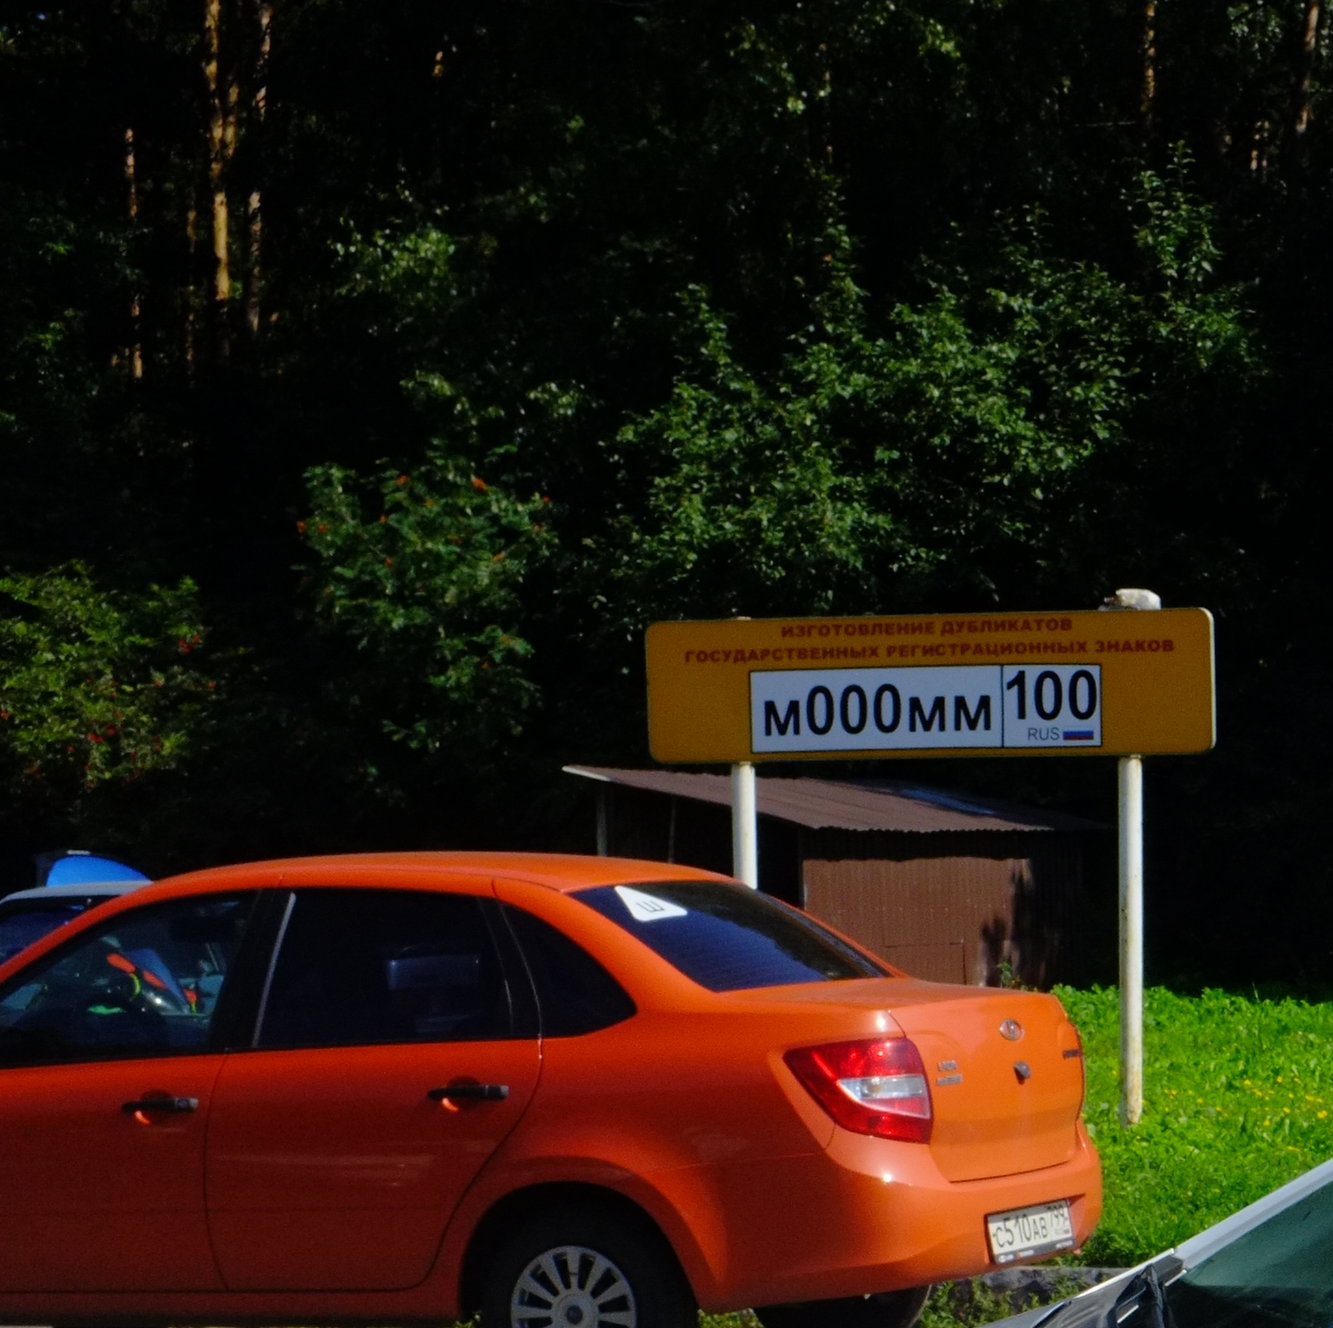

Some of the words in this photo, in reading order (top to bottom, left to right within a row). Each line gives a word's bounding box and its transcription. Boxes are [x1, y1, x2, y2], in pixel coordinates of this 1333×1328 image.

[780, 621, 934, 638] ИЗГОТОВЛЕНИЕ
[940, 617, 1073, 635] ДУБЛИКАТОВ
[684, 644, 879, 663] ГОСУДАРСТВЕННЫХ
[886, 640, 1089, 659] РЕГИСТРАЦИОННЫХ
[1095, 638, 1175, 653] ЗНАКОВ
[1005, 669, 1098, 721] 100
[1027, 727, 1061, 741] RUS
